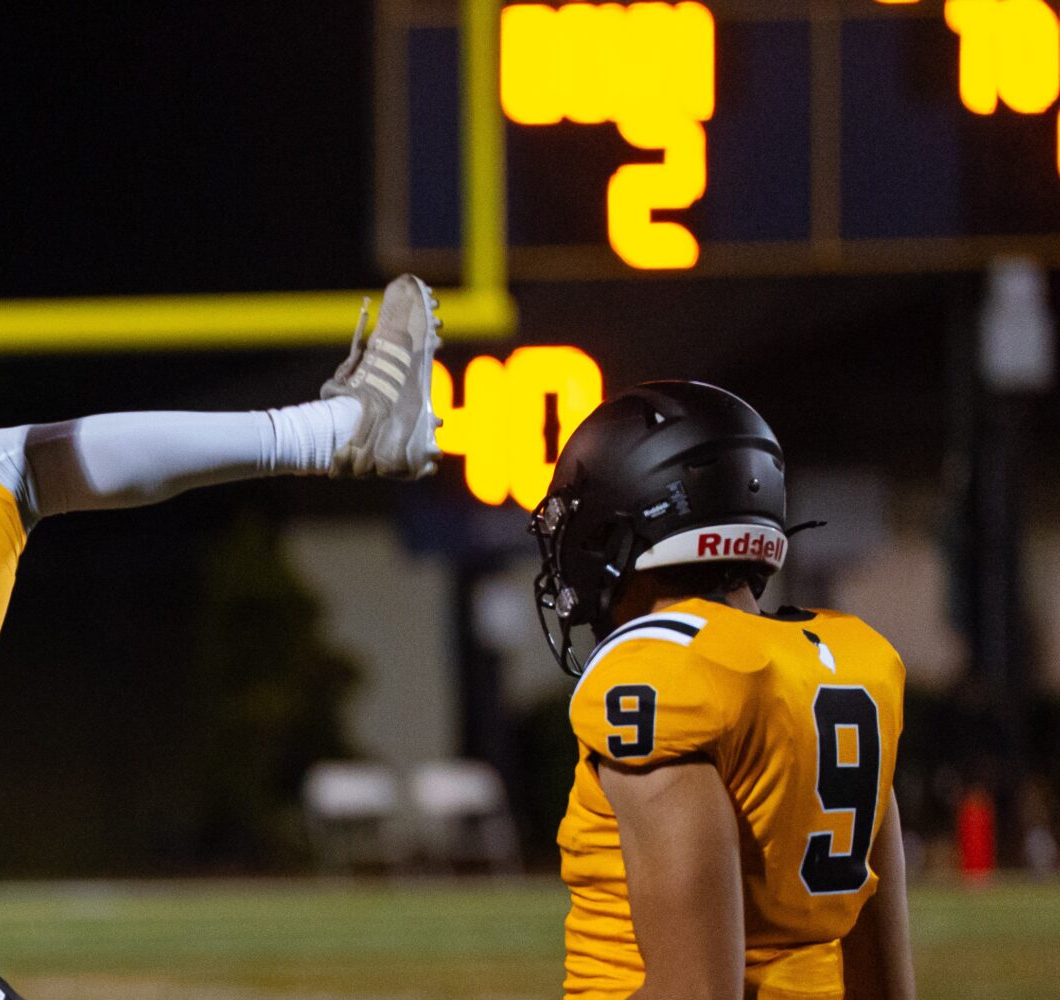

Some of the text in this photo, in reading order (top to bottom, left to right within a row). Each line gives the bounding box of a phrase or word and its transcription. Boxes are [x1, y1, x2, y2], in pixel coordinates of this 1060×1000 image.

[697, 532, 785, 561] Riddell
[605, 684, 657, 759] 9
[799, 684, 883, 897] 9
